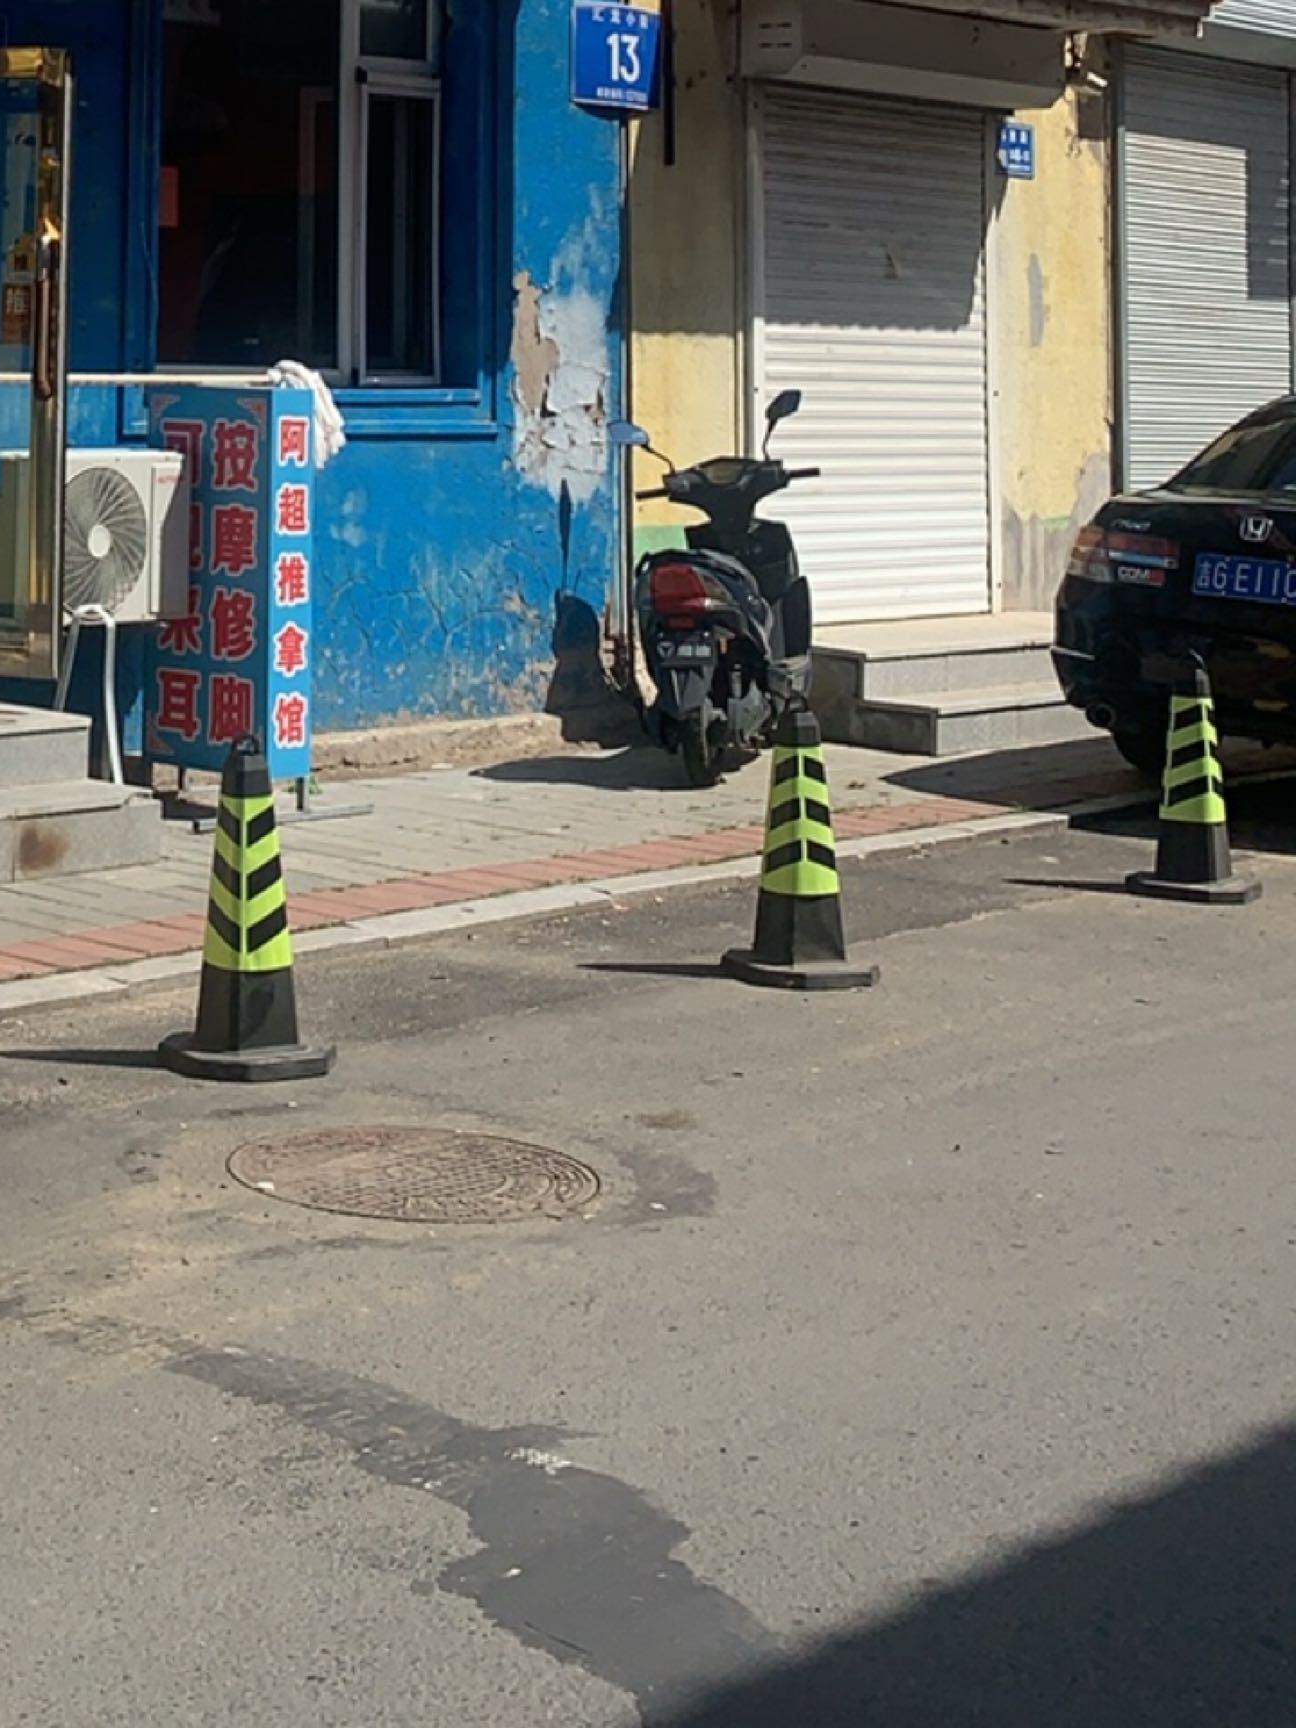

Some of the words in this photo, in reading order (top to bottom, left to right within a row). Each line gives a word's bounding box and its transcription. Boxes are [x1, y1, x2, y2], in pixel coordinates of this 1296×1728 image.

[605, 33, 640, 83] 13
[210, 419, 258, 743] 按摩修脚
[274, 416, 309, 750] 阿超推拿馆
